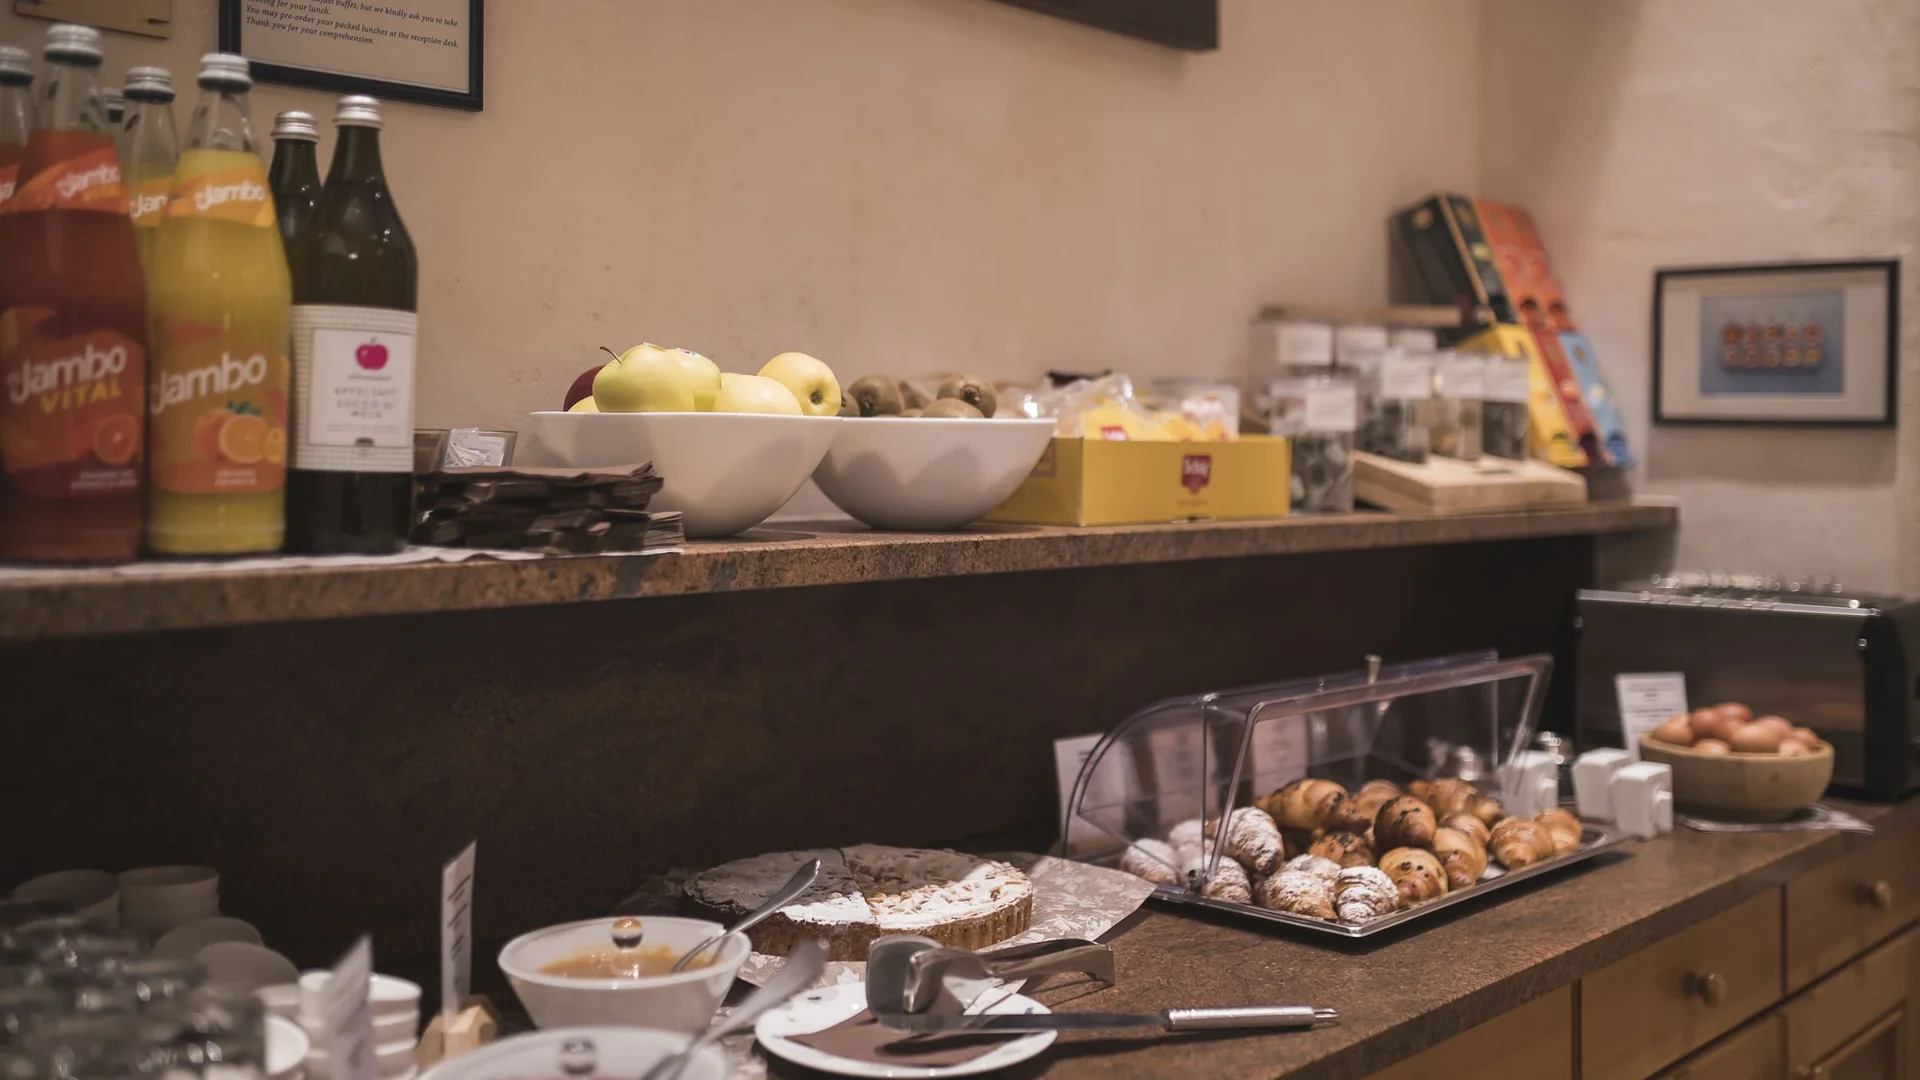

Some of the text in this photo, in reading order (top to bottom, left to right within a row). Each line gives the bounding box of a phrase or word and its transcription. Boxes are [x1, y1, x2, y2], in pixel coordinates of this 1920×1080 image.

[277, 0, 288, 8] for
[289, 3, 308, 11] your
[309, 4, 331, 15] lunch.
[336, 0, 359, 10] buffet,
[360, 3, 373, 11] but
[385, 7, 407, 19] kindly
[420, 15, 435, 23] you
[444, 18, 458, 27] take
[245, 16, 270, 27] Thank
[287, 23, 299, 32] for
[319, 31, 375, 44] comprehension.
[246, 5, 260, 13] You
[261, 9, 279, 18] may
[280, 12, 316, 23] pre-order
[316, 18, 334, 26] your
[334, 21, 361, 31] packed
[361, 24, 388, 36] lunches
[398, 31, 409, 39] the
[410, 34, 442, 45] reception
[442, 38, 459, 48] desk.
[42, 375, 122, 415] VITAL
